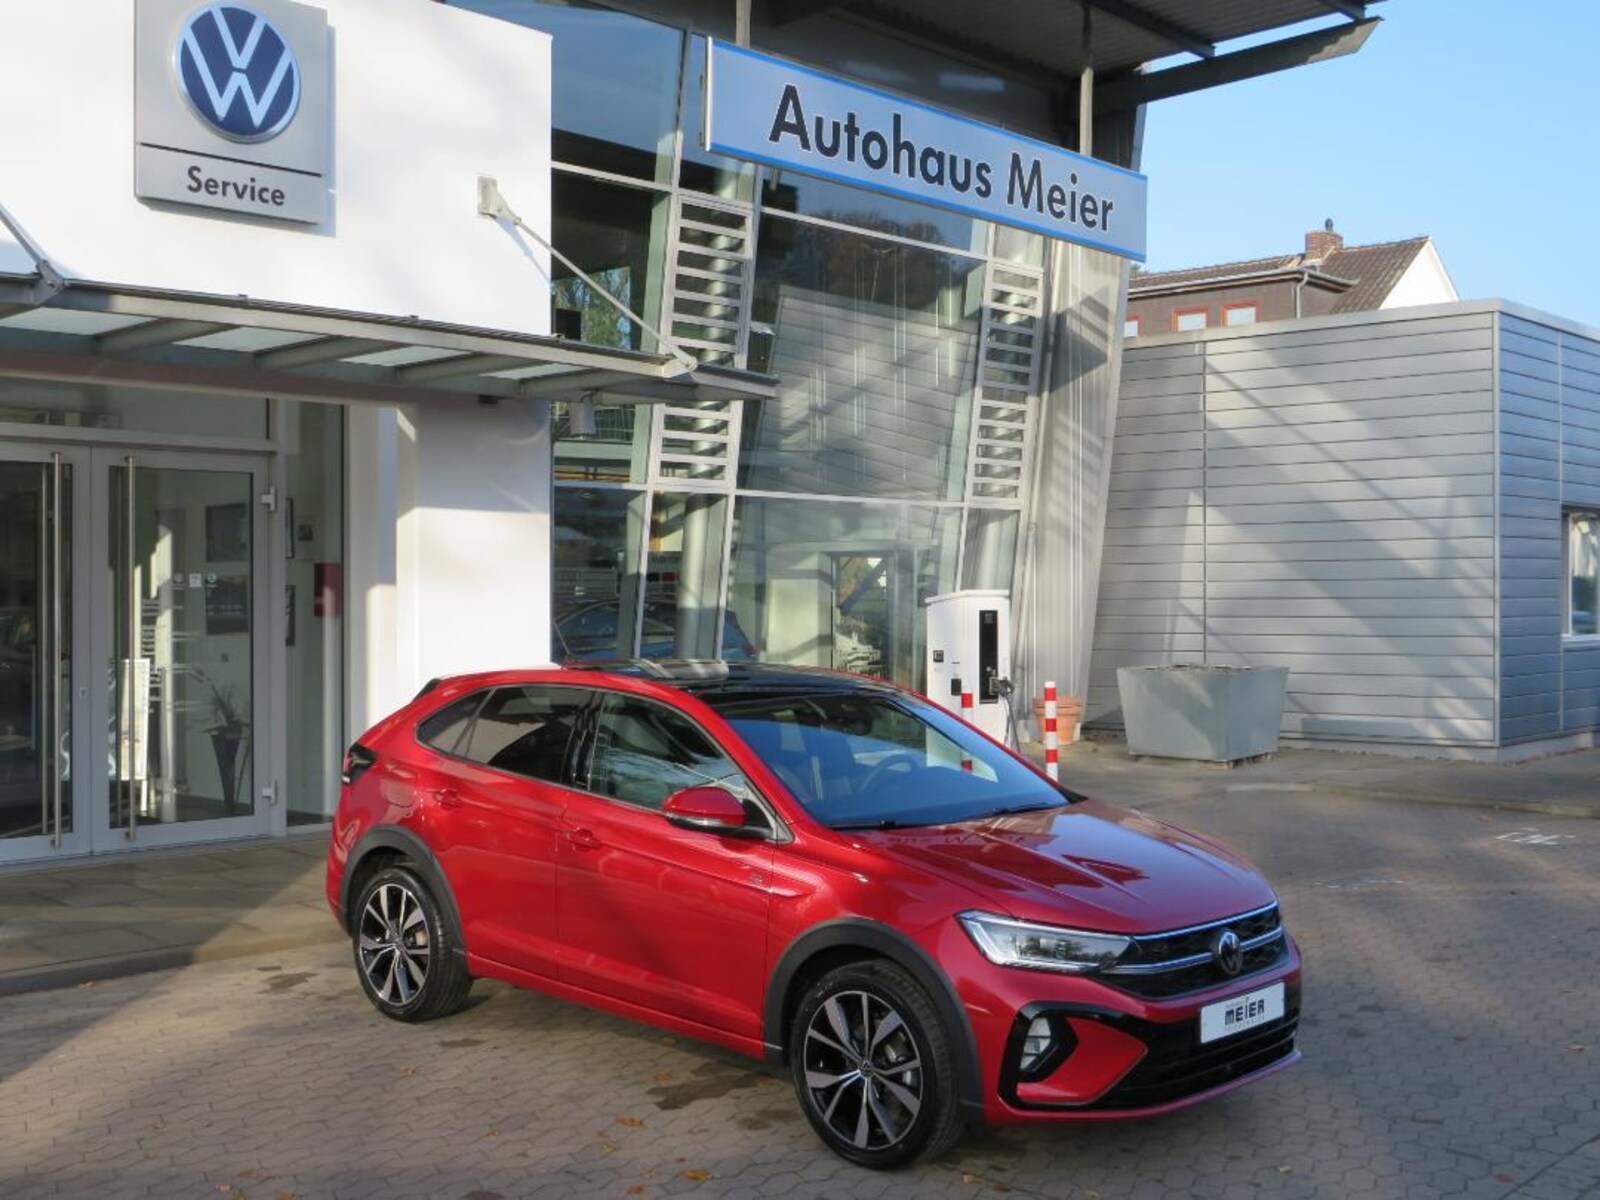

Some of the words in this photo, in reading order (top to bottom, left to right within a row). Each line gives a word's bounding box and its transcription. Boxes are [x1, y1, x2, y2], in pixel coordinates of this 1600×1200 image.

[769, 84, 992, 198] Autohaus
[1007, 152, 1113, 231] Meier
[187, 166, 285, 206] Service
[1225, 999, 1264, 1025] MEIER
